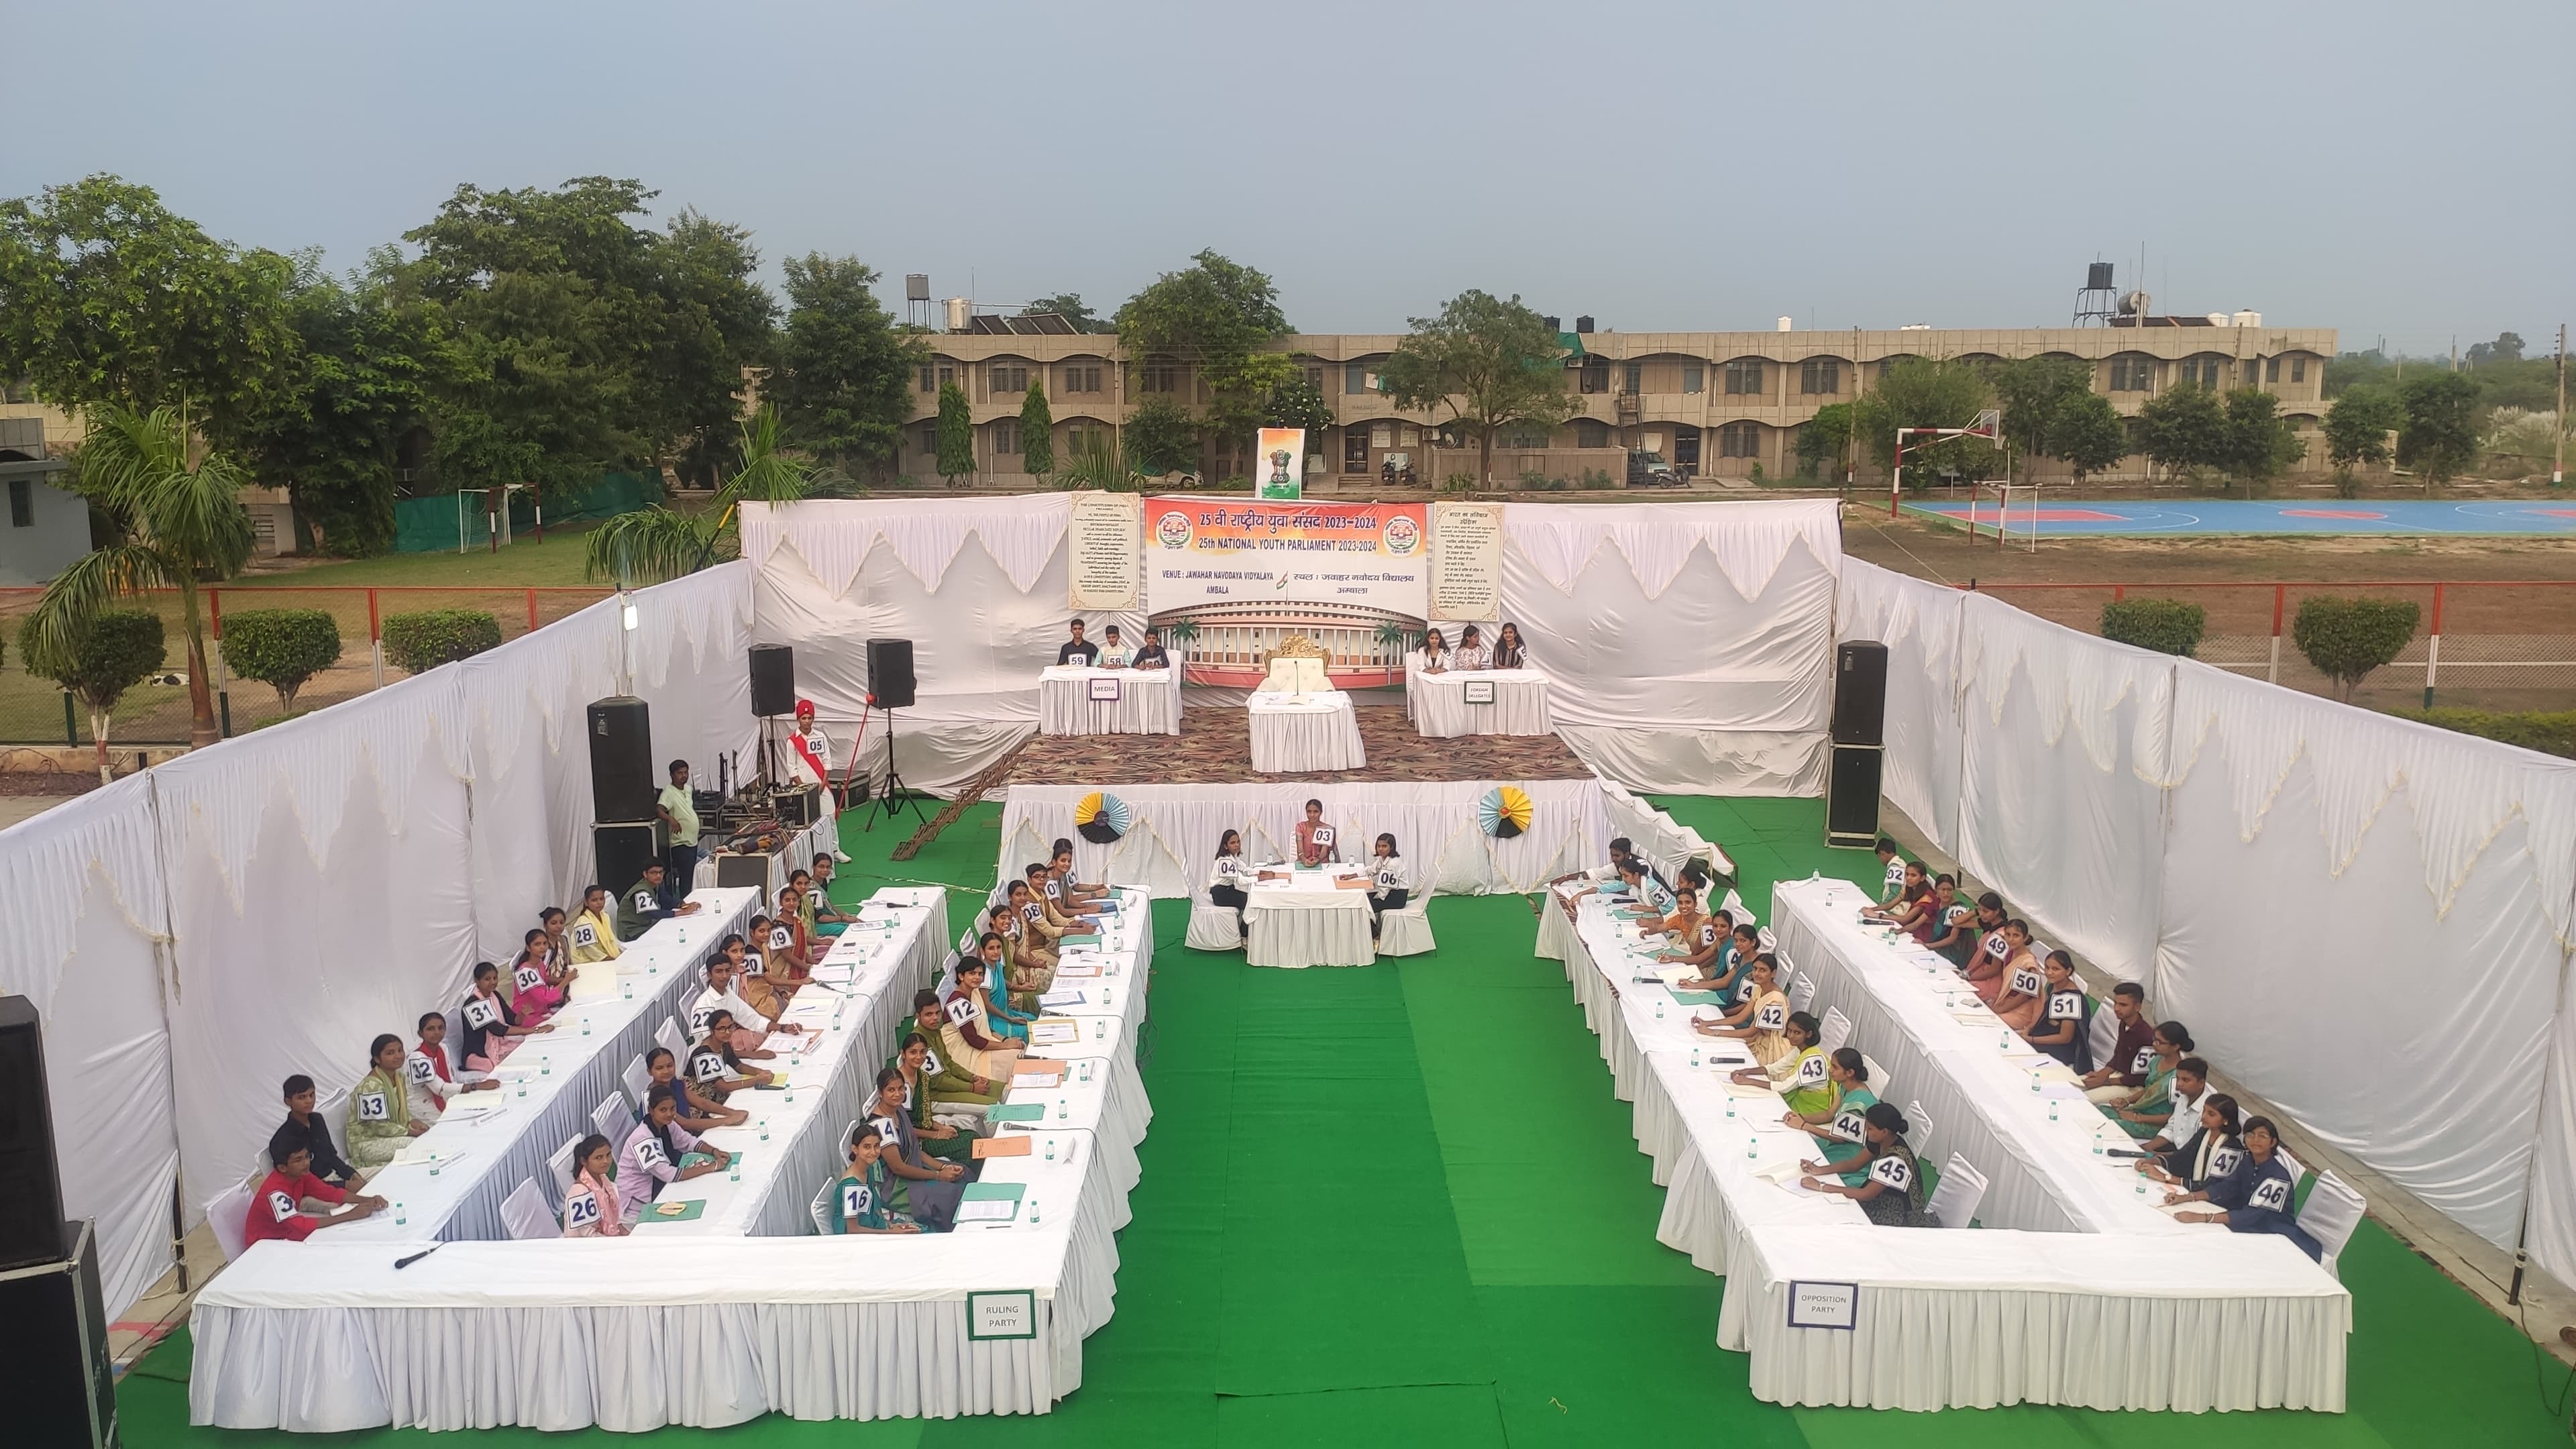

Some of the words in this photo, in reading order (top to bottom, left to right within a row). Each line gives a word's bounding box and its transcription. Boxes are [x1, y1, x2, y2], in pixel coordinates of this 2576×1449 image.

[1200, 514, 1211, 526] 25
[1215, 509, 1226, 527] वी
[1230, 509, 1263, 531] राष्ट्रीय
[1268, 515, 1288, 533] युवा
[1293, 513, 1322, 529] संसद
[1199, 537, 1215, 549] 25th
[1218, 537, 1256, 549] NATIONAL
[1259, 539, 1285, 550] YOUTH
[1287, 539, 1336, 551] PARLIAMENT
[1338, 540, 1377, 551] 2023-2024
[1185, 570, 1212, 579] JAWAHAR
[1214, 571, 1242, 580] NAVODAYA
[1244, 572, 1273, 580] VIDYALAYA
[1321, 574, 1350, 582] जवाहर
[1351, 572, 1380, 582] नवोदय
[1382, 572, 1414, 582] विद्यालय
[1206, 586, 1229, 594] AMBALA
[1071, 657, 1083, 665] 59
[1110, 657, 1121, 665] 58
[810, 741, 822, 751] 05
[1316, 830, 1330, 842] 03
[1221, 863, 1236, 873] 04
[1887, 869, 1902, 881] 02
[1381, 873, 1397, 885] 06
[639, 896, 654, 908] 27
[1654, 888, 1668, 904] 37
[1024, 905, 1040, 920] 08
[576, 928, 592, 943] 28
[772, 932, 786, 947] 19
[1705, 928, 1715, 943] 3
[1988, 938, 2006, 954] 49
[743, 959, 758, 972] 20
[519, 970, 537, 987] 30
[2016, 974, 2036, 991] 50
[1742, 985, 1753, 999] 4
[471, 1004, 492, 1022] 31
[953, 1001, 975, 1020] 12
[2054, 998, 2074, 1014] 51
[1762, 1008, 1782, 1025] 42
[413, 1062, 432, 1079] 32
[699, 1057, 722, 1076] 23
[925, 1055, 935, 1072] 3
[1803, 1059, 1823, 1078] 43
[362, 1097, 383, 1116] 33
[1837, 1116, 1861, 1138] 44
[2214, 1153, 2238, 1173] 47
[1878, 1160, 1905, 1183] 45
[848, 1189, 868, 1211] 16
[2258, 1183, 2284, 1204] 46
[572, 1197, 596, 1222] 26
[1801, 1295, 1846, 1303] OPPOSITION
[986, 1305, 1019, 1314] RULING
[989, 1319, 1017, 1328] PARTY
